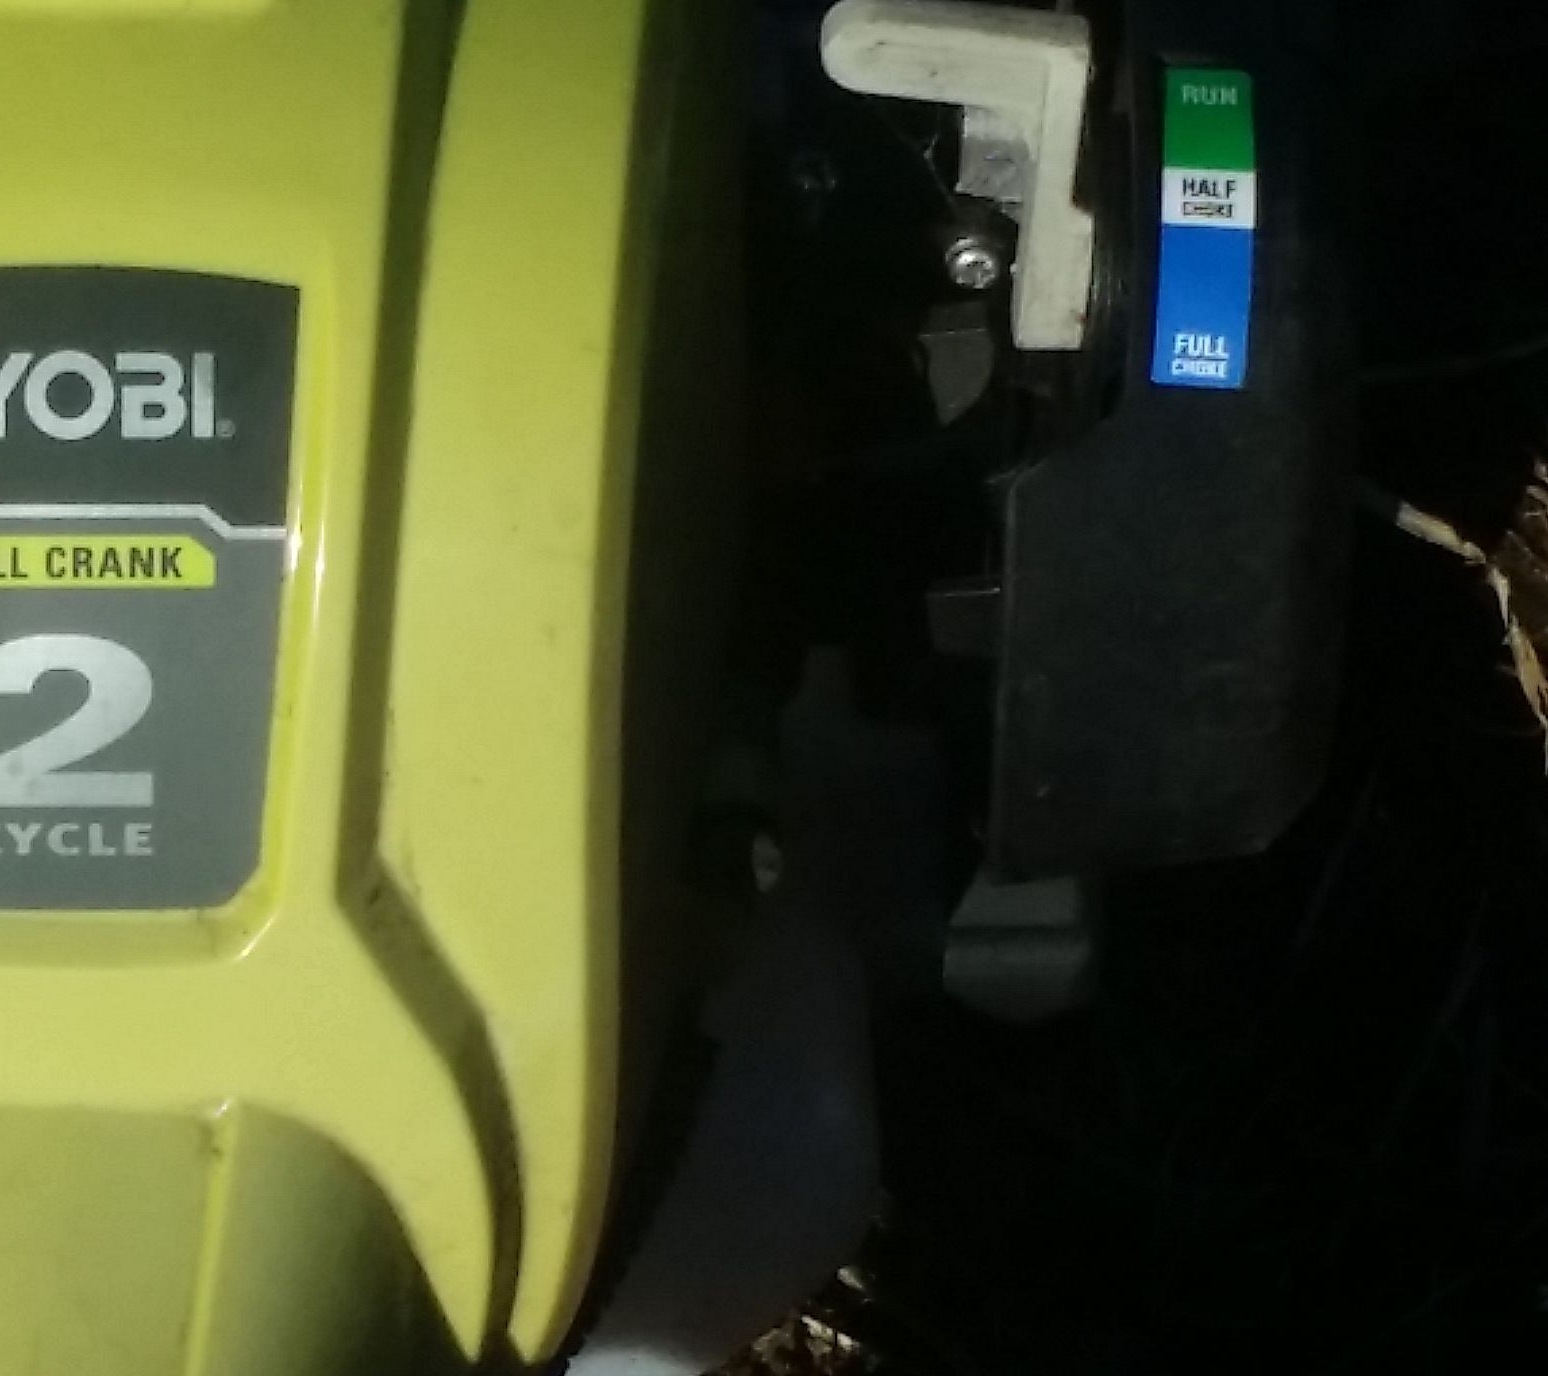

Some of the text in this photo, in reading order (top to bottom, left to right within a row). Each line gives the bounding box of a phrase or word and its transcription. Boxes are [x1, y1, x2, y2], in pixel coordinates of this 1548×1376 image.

[1182, 177, 1237, 199] HALF
[1173, 333, 1229, 357] FULL
[44, 546, 183, 580] CRANK
